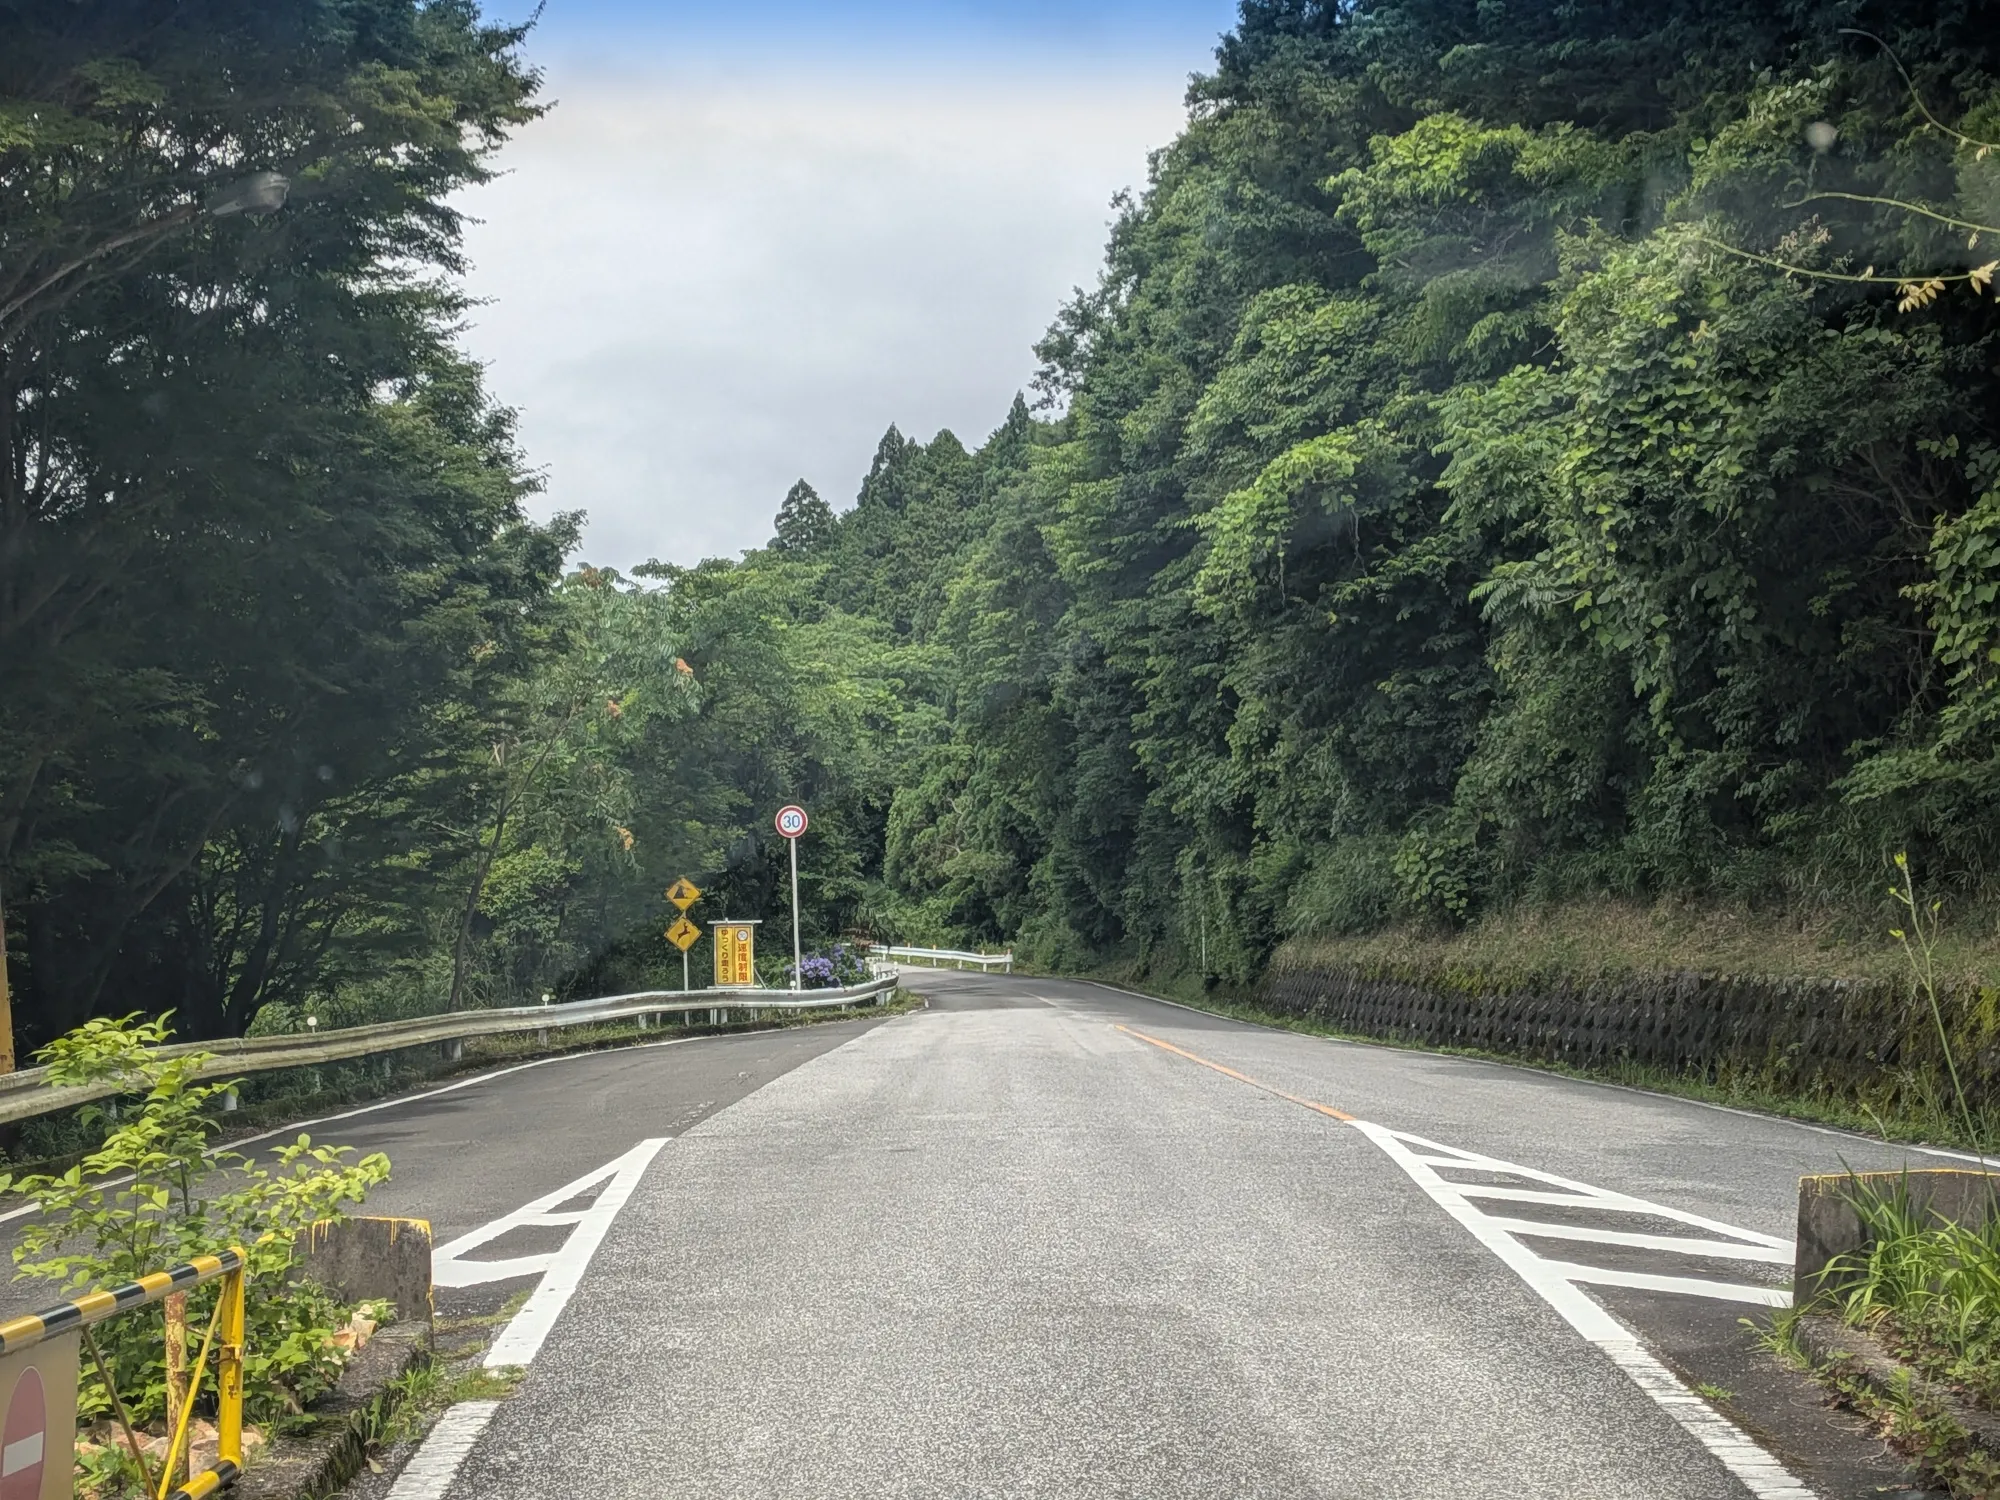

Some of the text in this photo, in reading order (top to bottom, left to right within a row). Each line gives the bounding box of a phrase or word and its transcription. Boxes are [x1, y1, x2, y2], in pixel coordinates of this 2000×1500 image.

[784, 815, 800, 828] 30
[738, 943, 747, 981] 速度制限
